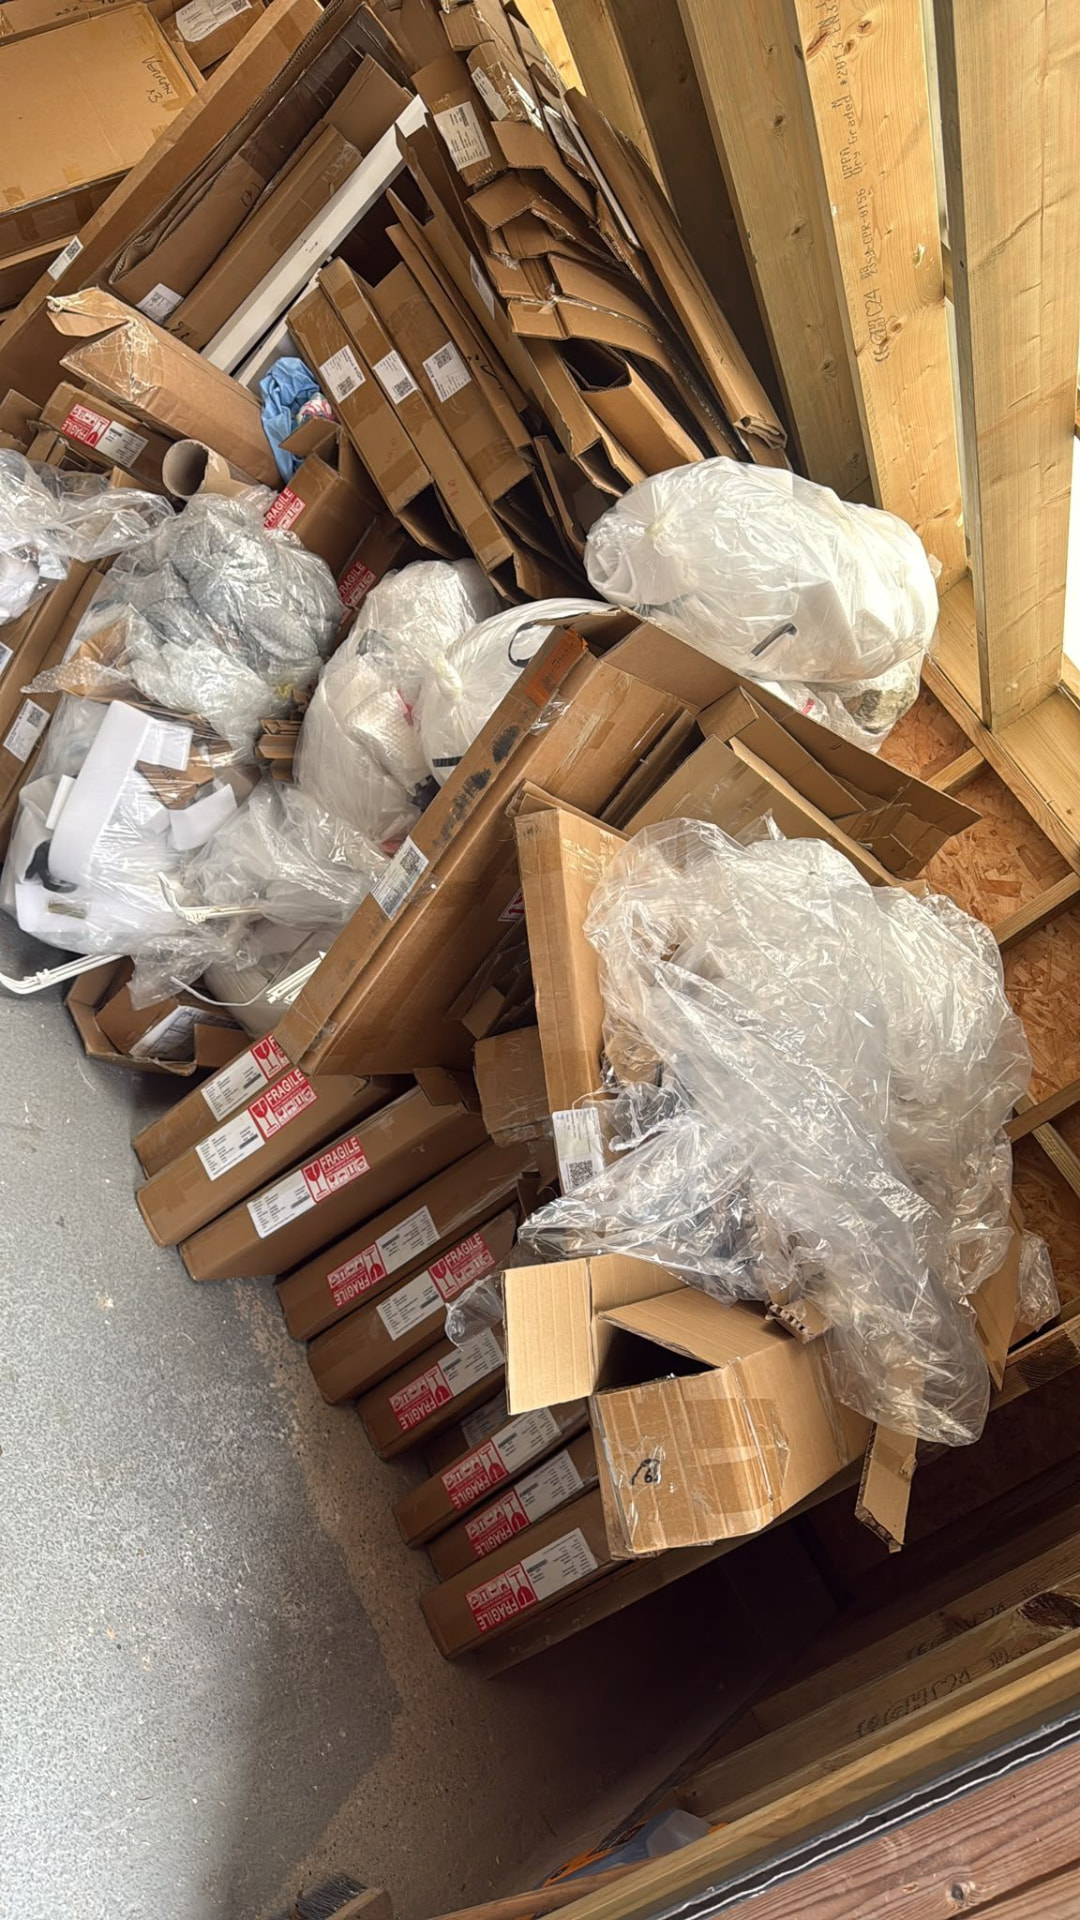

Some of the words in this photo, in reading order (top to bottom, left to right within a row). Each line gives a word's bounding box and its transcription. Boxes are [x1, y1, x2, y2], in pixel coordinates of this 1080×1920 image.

[864, 287, 884, 317] C24
[338, 561, 366, 595] RAGILE
[266, 1068, 304, 1105] FRAGILE
[320, 1136, 361, 1171] FRAGILE
[447, 1233, 483, 1267] FRAGILE
[335, 1277, 371, 1307] FRAGILE
[399, 1398, 437, 1430] FRAGILE
[453, 1479, 491, 1509] FRAGILE
[475, 1525, 513, 1556] FRAGILE
[477, 1602, 519, 1632] FRAGILE
